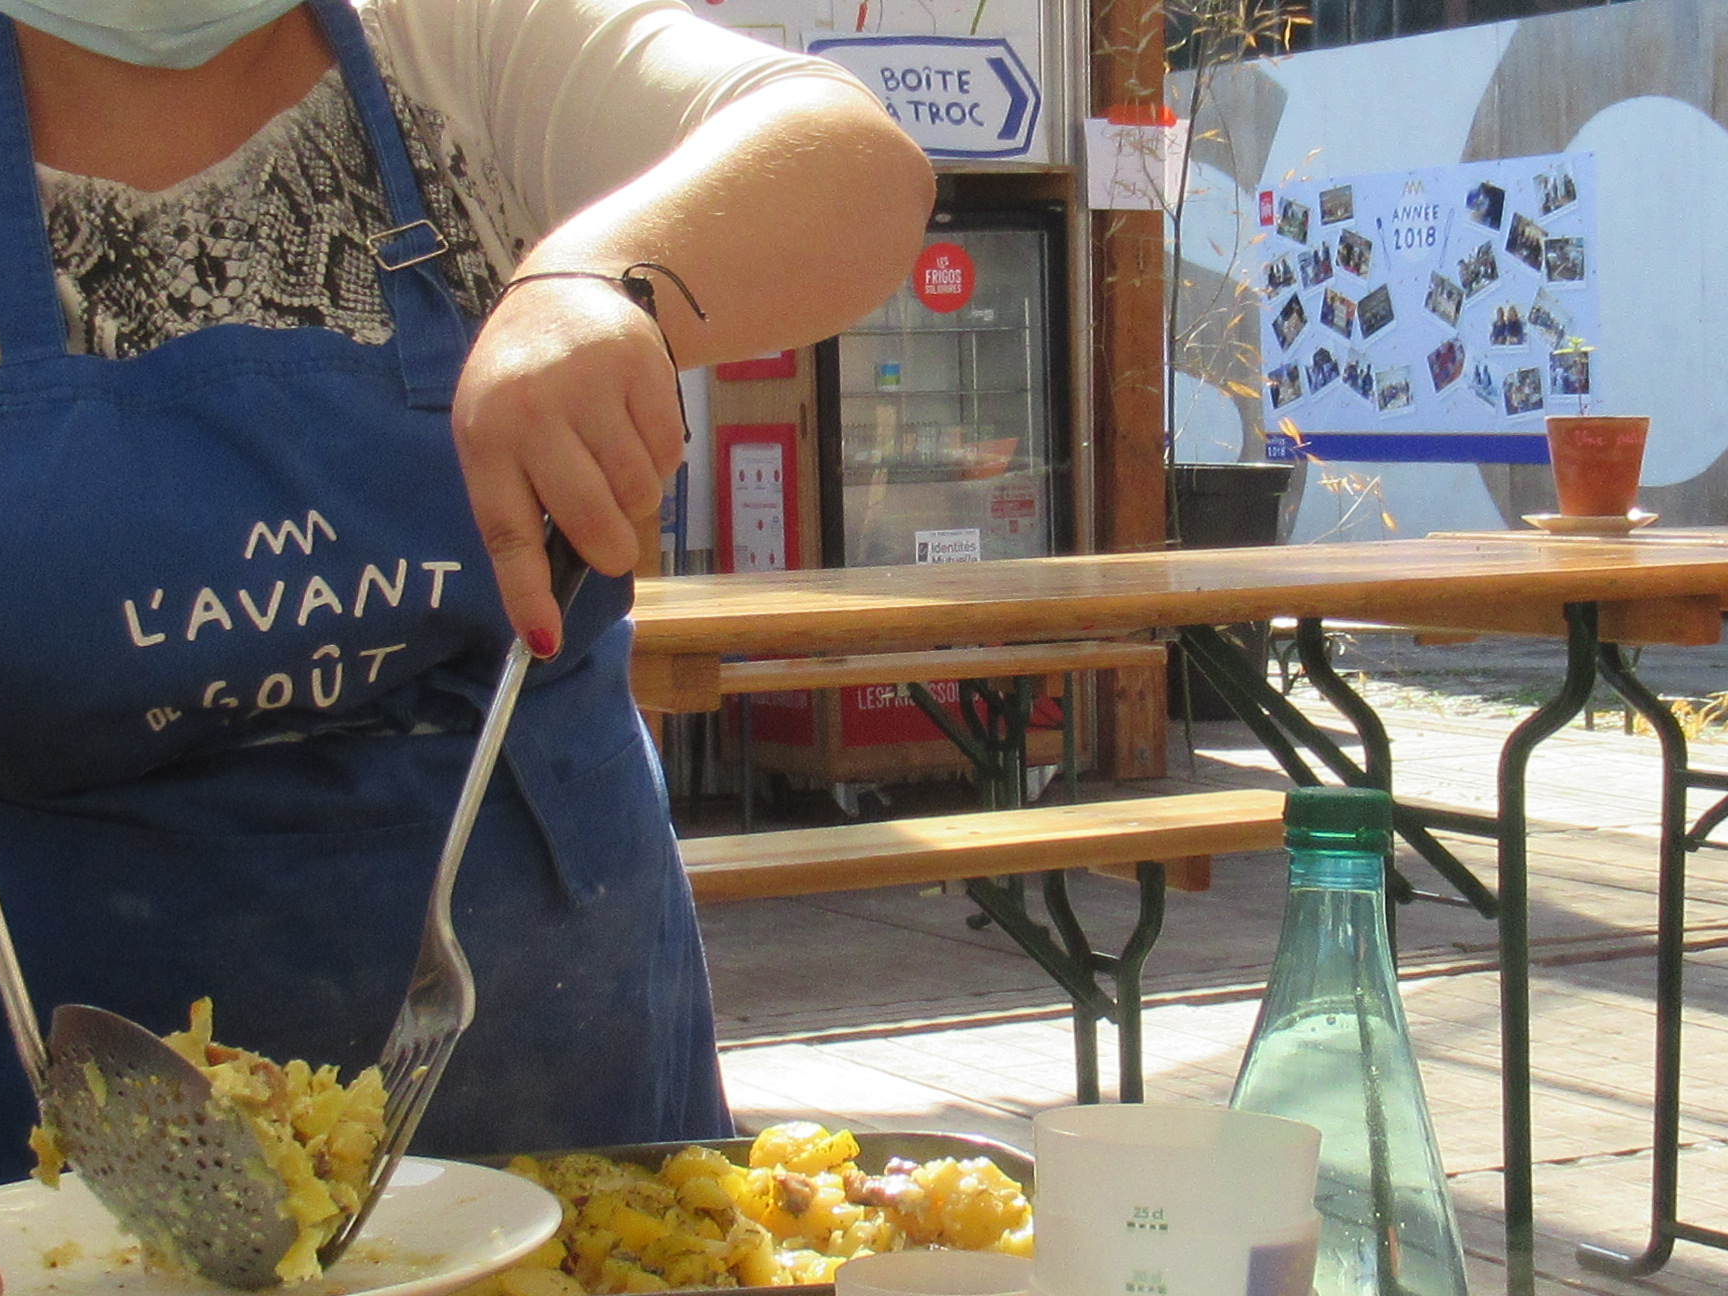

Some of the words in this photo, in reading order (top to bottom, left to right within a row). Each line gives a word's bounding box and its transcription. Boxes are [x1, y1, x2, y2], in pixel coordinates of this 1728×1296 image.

[880, 66, 971, 94] BOÎTE
[906, 100, 984, 127] TROC
[1392, 203, 1440, 224] ANNÉE
[1394, 225, 1437, 250] 2018
[925, 269, 962, 284] FRIGOS
[124, 559, 462, 648] L'AVANT
[203, 644, 407, 709] GOÛT
